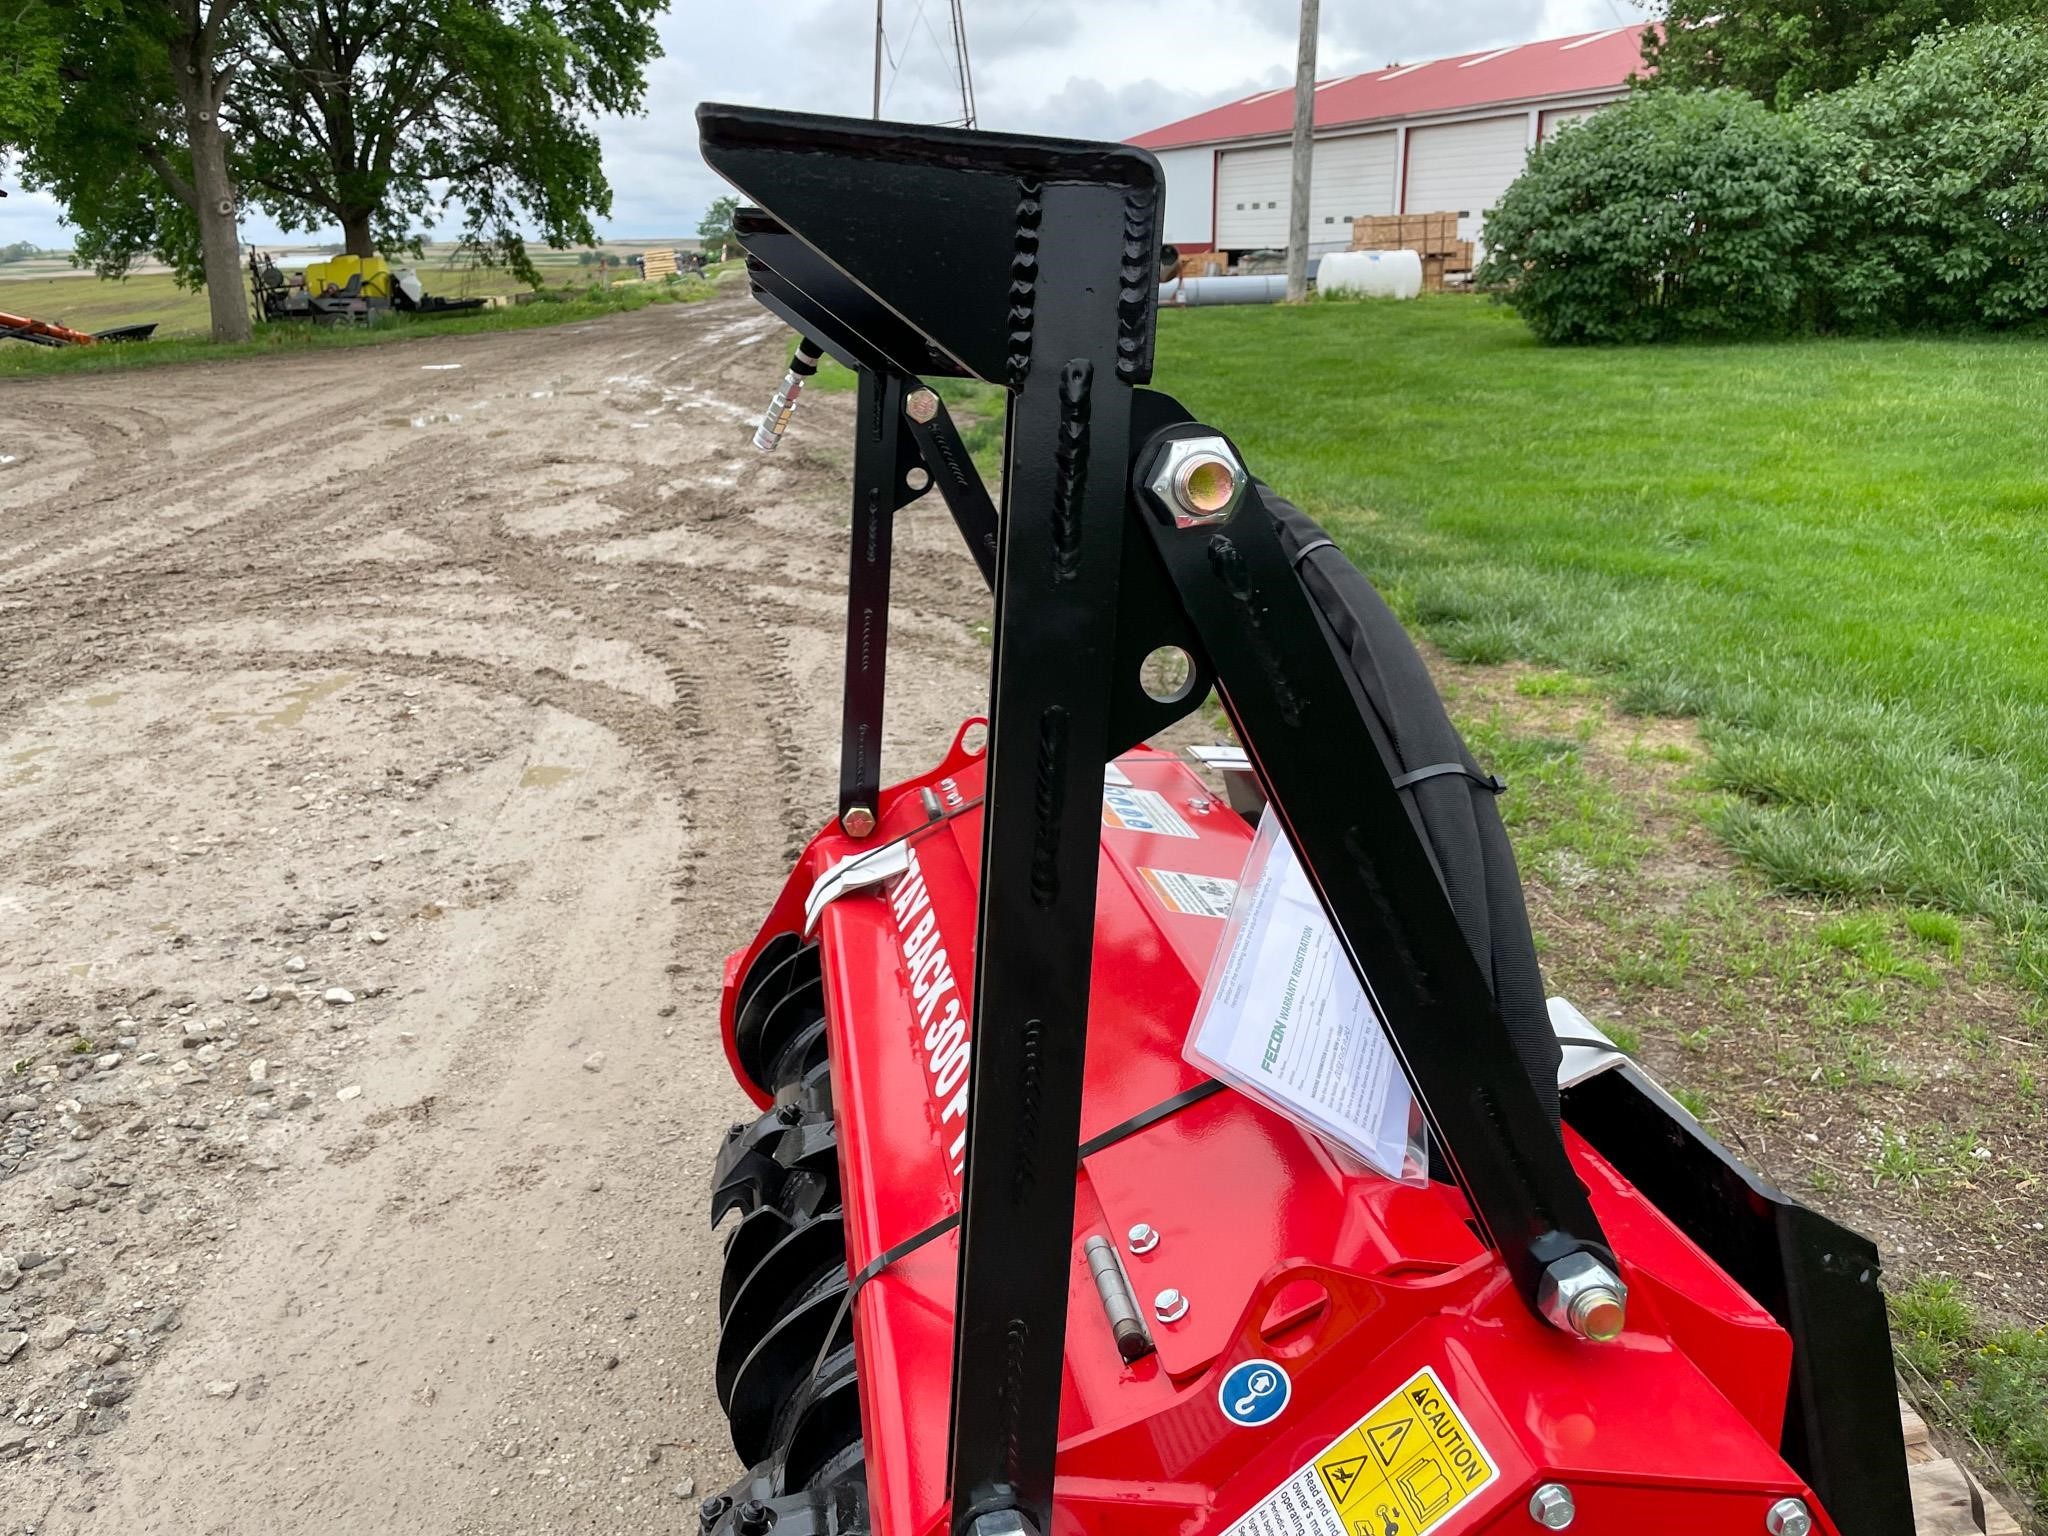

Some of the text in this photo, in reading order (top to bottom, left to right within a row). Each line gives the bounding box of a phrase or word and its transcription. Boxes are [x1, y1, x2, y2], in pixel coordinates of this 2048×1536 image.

[891, 848, 930, 932] TAY
[903, 907, 955, 1029] BACK
[1261, 1019, 1287, 1074] FECON
[1279, 976, 1298, 1021] WARRANTY
[1291, 925, 1313, 978] REGISTRATION
[924, 998, 971, 1097] 300
[1422, 1398, 1482, 1482] CAUTION
[1269, 1500, 1285, 1530] Periodic
[1280, 1491, 1305, 1536] operating
[1292, 1482, 1313, 1519] owner's
[1304, 1471, 1320, 1497] Read
[1315, 1497, 1330, 1517] and
